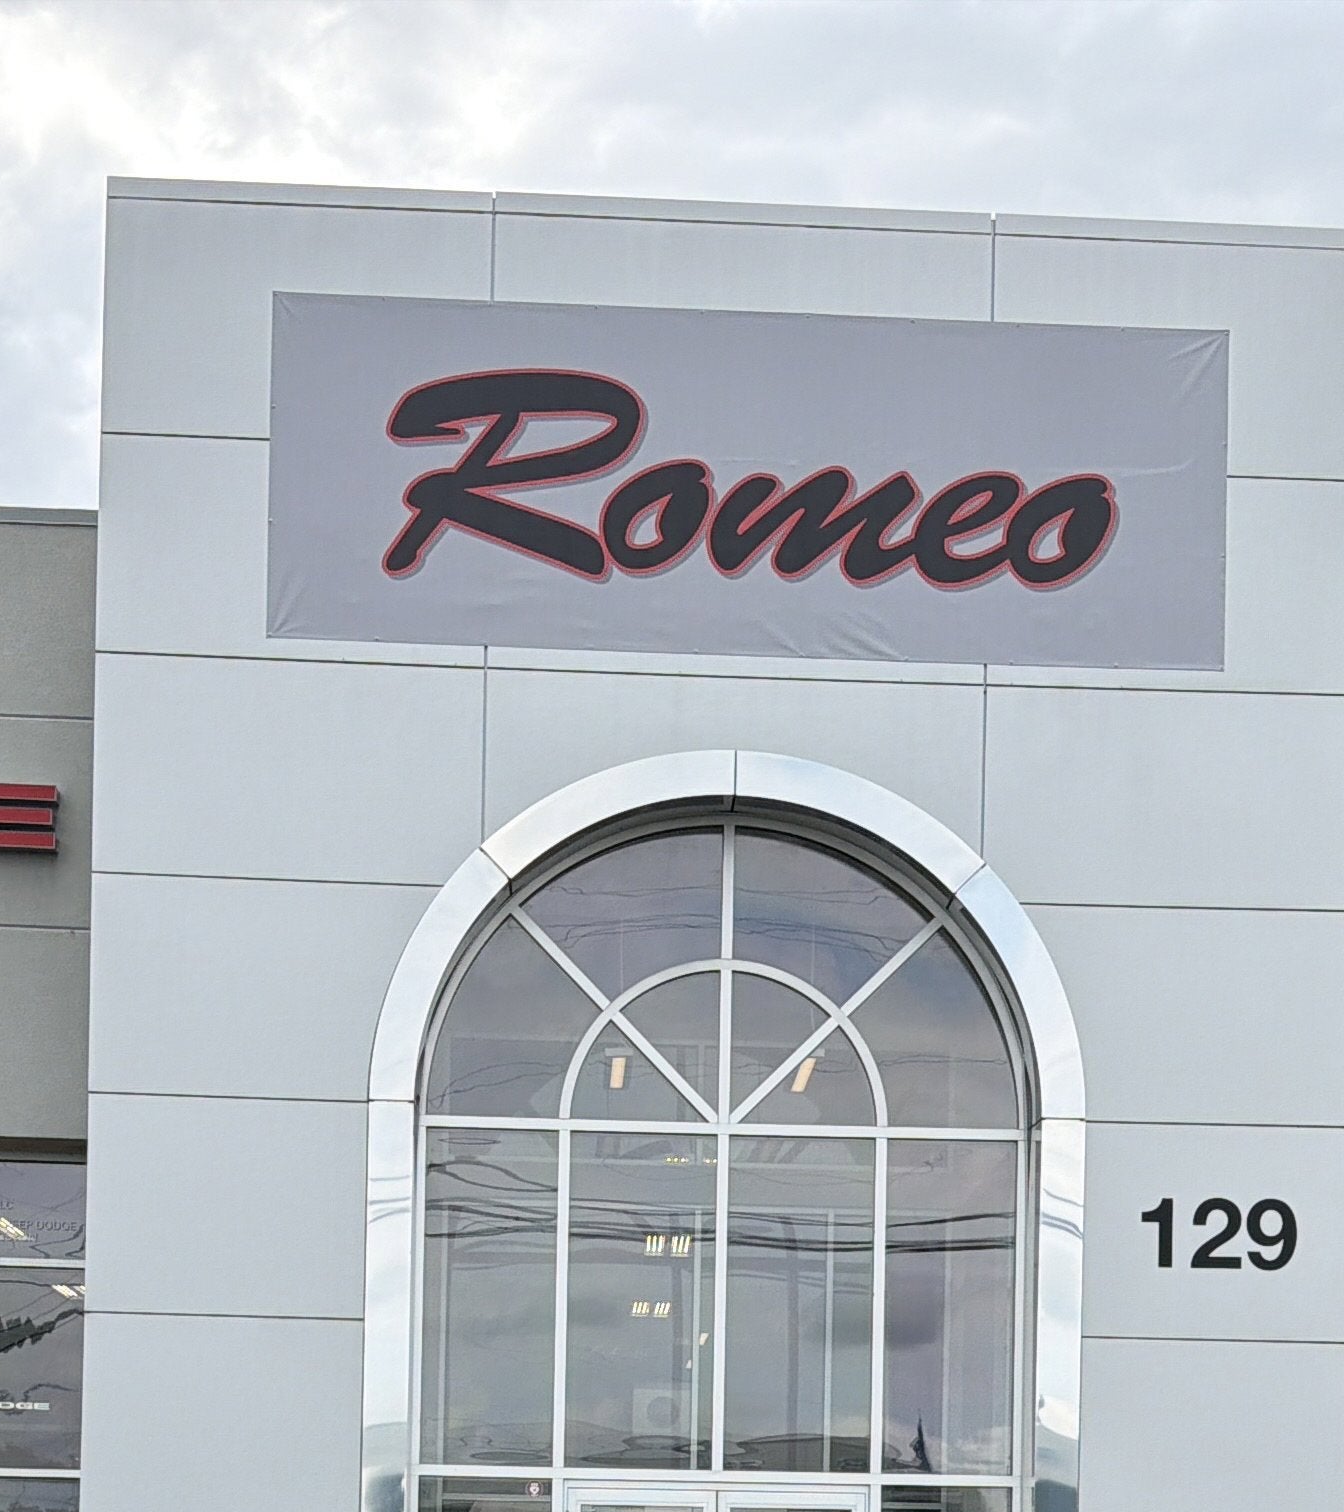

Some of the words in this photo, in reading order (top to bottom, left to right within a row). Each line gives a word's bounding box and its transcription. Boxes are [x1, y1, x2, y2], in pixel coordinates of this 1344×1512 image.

[381, 367, 1119, 592] Romeo
[36, 1220, 77, 1232] DODGE
[1141, 1197, 1298, 1271] 129
